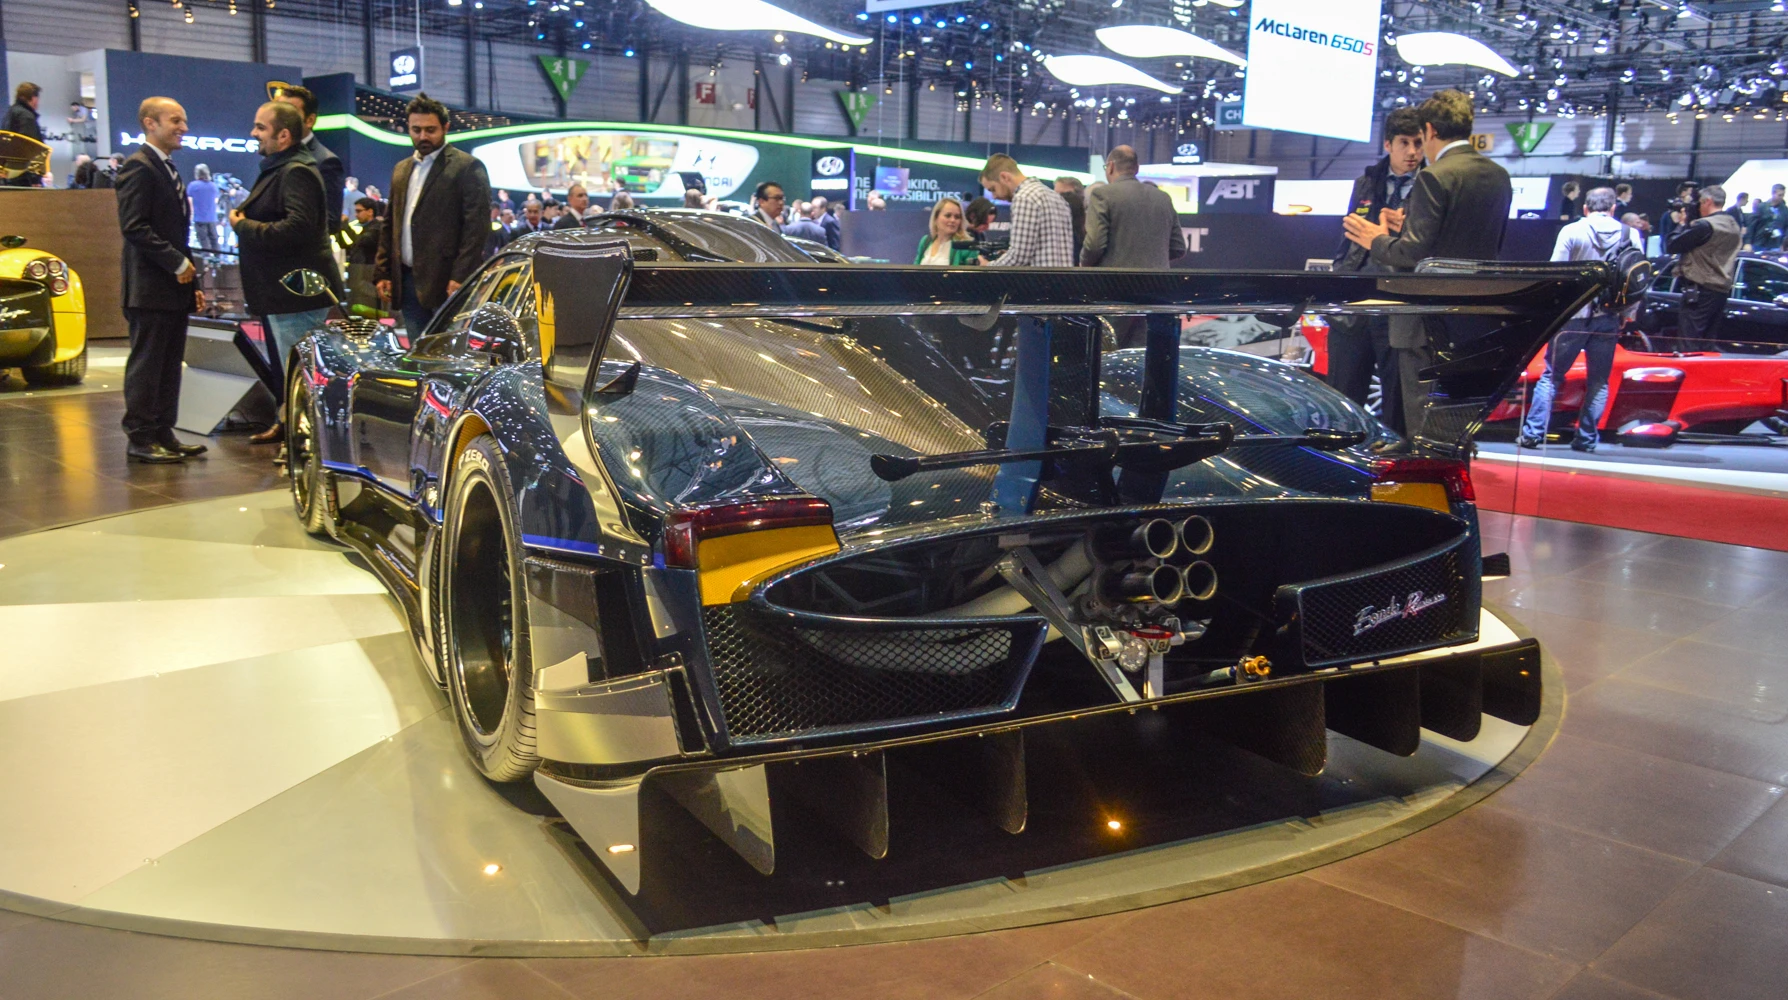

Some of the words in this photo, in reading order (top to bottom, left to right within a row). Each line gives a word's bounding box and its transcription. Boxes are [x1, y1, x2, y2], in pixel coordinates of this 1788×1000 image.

[1255, 17, 1328, 46] McLaren
[1330, 34, 1375, 56] 650S
[701, 84, 712, 99] F
[1205, 179, 1261, 205] ABT
[464, 449, 490, 472] ZERO
